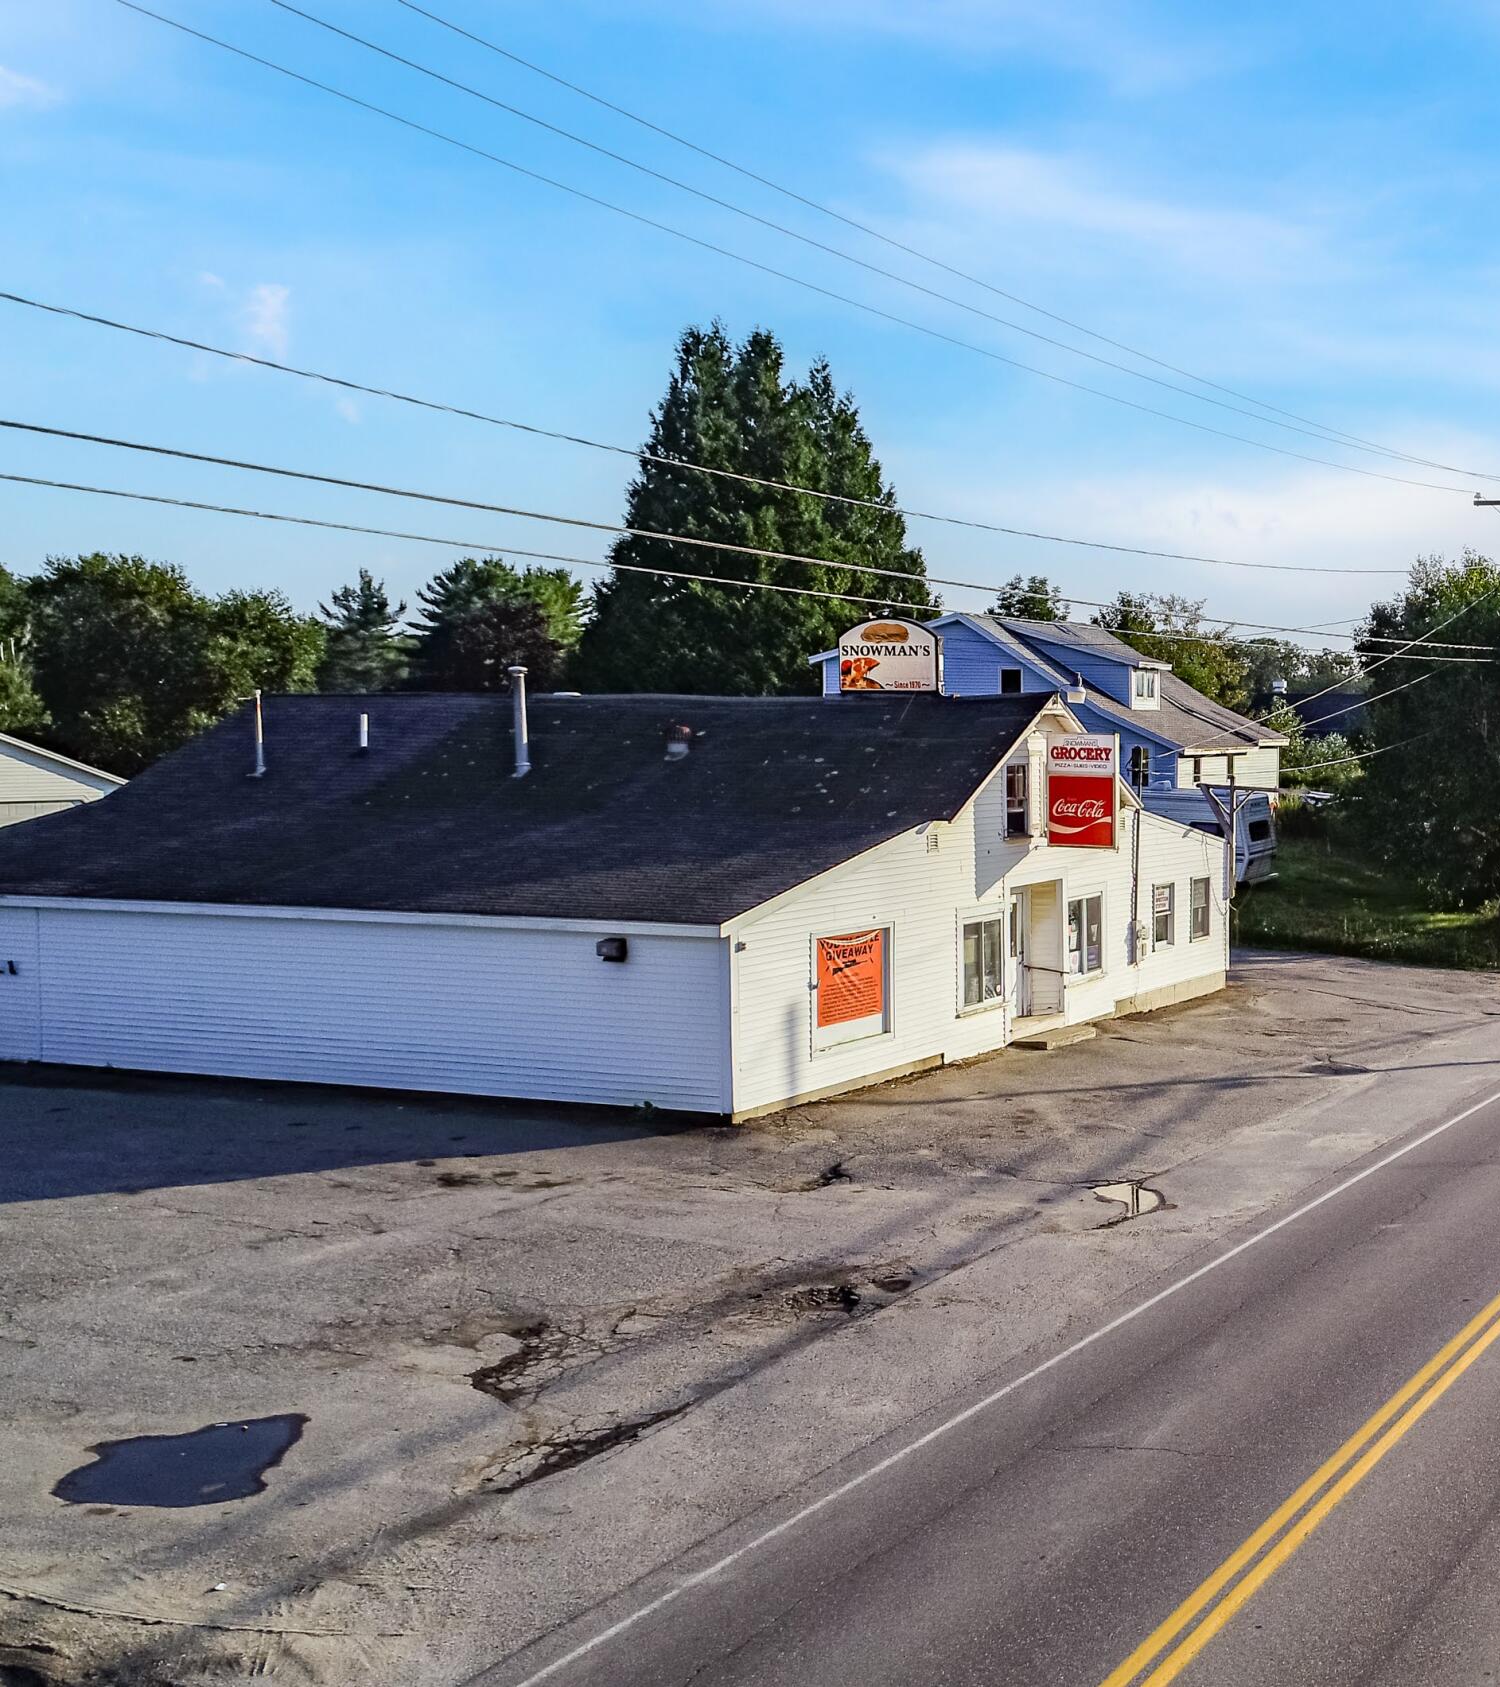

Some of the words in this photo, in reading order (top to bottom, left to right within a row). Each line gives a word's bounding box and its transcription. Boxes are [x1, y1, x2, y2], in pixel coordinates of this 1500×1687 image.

[841, 645, 931, 657] SNOWMAN'S
[894, 681, 909, 689] Since
[909, 681, 922, 689] 1970
[1050, 746, 1113, 761] GROCERY
[1052, 799, 1106, 818] Coca-Cola
[825, 944, 874, 962] GIVEAWAY
